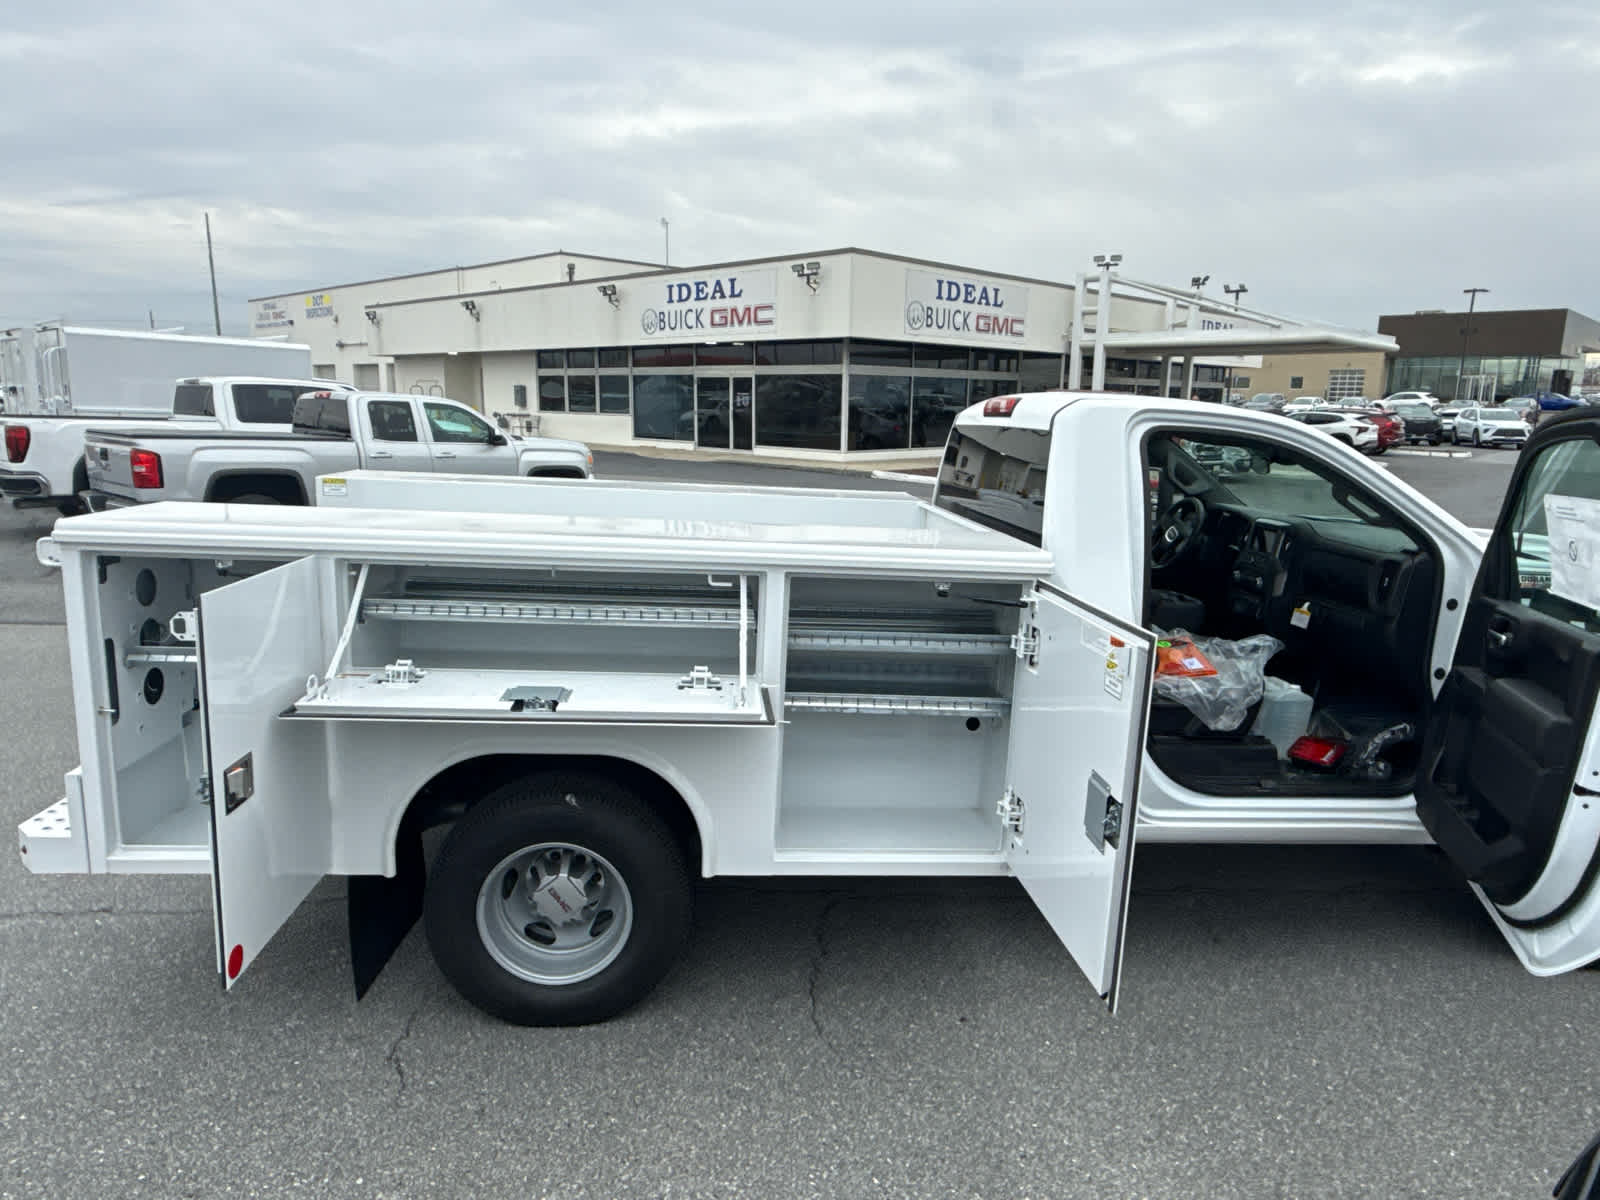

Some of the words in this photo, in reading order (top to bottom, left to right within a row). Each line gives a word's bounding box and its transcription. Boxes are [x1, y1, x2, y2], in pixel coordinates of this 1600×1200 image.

[666, 278, 743, 303] IDEAL
[935, 279, 1004, 308] IDEAL
[658, 308, 704, 331] BUICK
[710, 304, 774, 328] GMC
[925, 306, 971, 332] BUICK
[975, 314, 1024, 337] GMC
[547, 887, 573, 913] GMC
